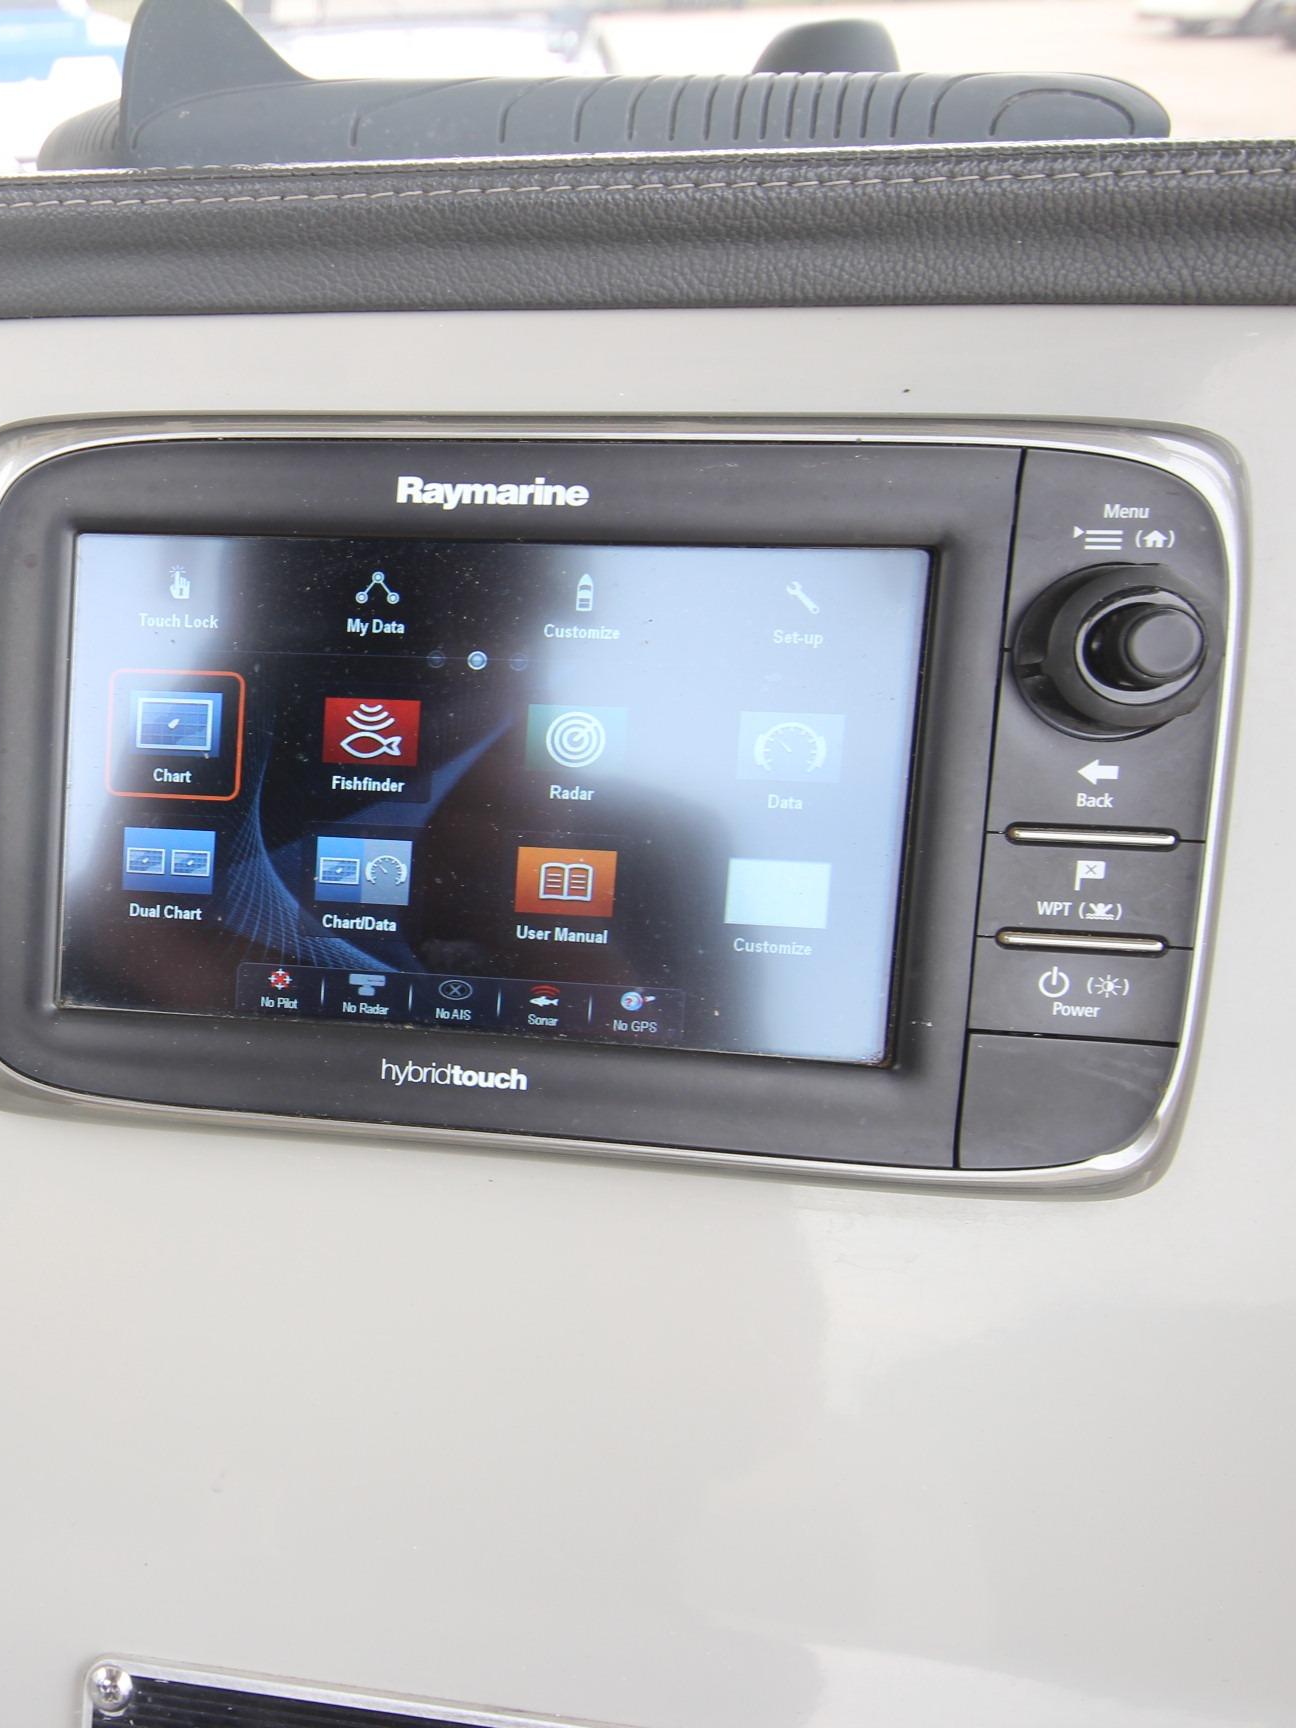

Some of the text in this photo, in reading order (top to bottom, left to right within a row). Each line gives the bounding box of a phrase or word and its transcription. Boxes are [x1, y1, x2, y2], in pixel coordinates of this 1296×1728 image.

[396, 476, 590, 510] Raymarine
[1103, 503, 1150, 519] Menu
[138, 612, 219, 630] Touch Lock
[346, 618, 405, 637] My Data
[543, 623, 621, 640] Customize
[772, 629, 824, 648] Set-up
[153, 768, 192, 783] Chart
[331, 775, 405, 793] Fishfinder
[549, 784, 595, 801] Radar
[1076, 793, 1115, 808] Back
[767, 794, 803, 810] Data
[129, 903, 202, 921] Dual Chart
[1036, 901, 1073, 916] WPT
[322, 914, 397, 932] Chart/Data
[516, 925, 608, 944] User Manual
[733, 937, 812, 956] Customize
[260, 996, 298, 1010] No Pilot
[342, 1002, 390, 1016] No Radar
[1052, 1001, 1101, 1018] Power
[435, 1007, 472, 1021] No AIS
[528, 1013, 559, 1027] Sonar
[613, 1019, 658, 1033] No GPS
[380, 1058, 528, 1091] hybridtouch
